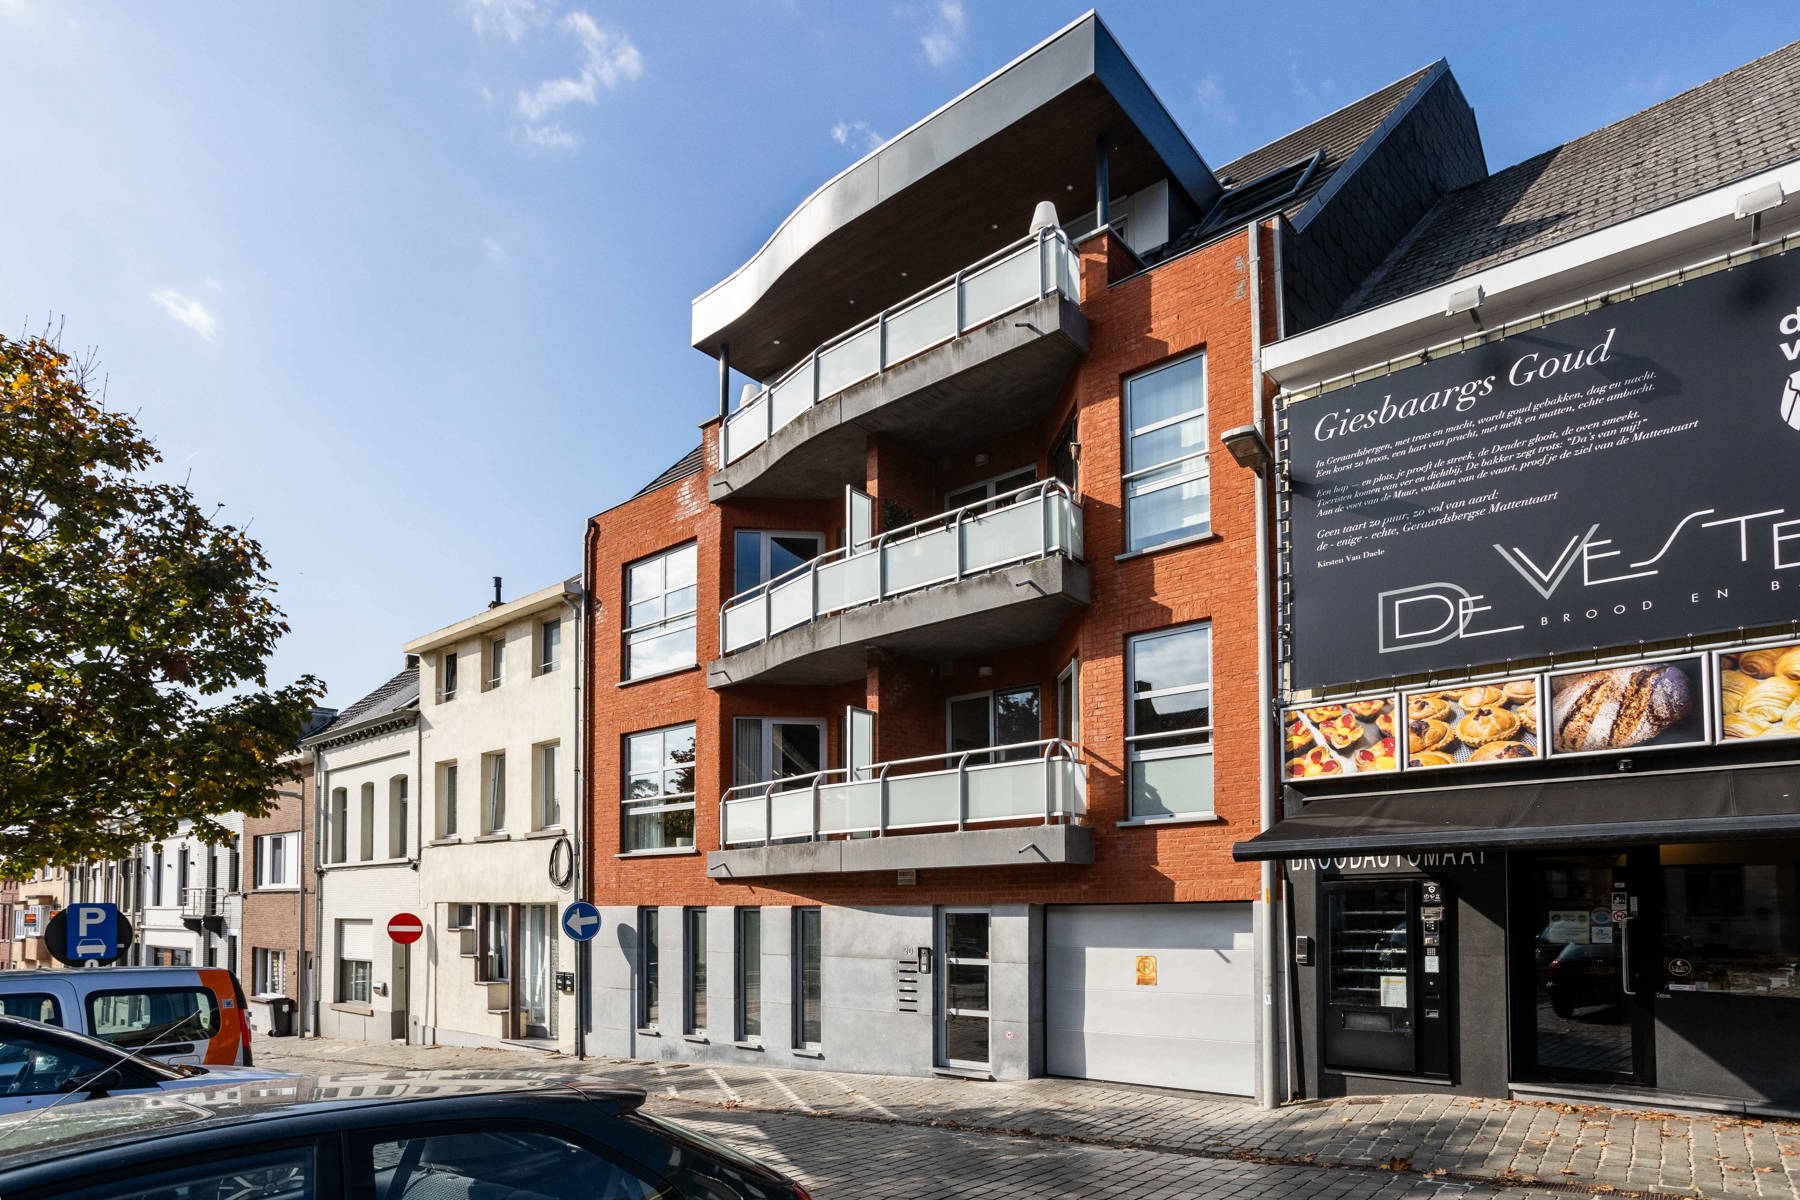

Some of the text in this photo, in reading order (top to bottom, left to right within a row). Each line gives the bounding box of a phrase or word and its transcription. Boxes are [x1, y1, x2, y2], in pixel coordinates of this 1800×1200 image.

[1780, 306, 1800, 335] d
[1314, 328, 1617, 442] Giesbaargs Goud
[1316, 460, 1324, 469] In
[1327, 443, 1392, 465] Geraardsbergen,
[1395, 439, 1410, 447] met
[1412, 433, 1431, 443] trots
[1445, 420, 1475, 434] macht,
[1478, 410, 1505, 425] wordt
[1507, 403, 1532, 419] goud
[1533, 392, 1584, 412] gebakken,
[1586, 385, 1608, 396] dag
[1609, 381, 1622, 390] en
[1624, 371, 1657, 386] nacht.
[1316, 470, 1332, 479] Een
[1333, 464, 1353, 474] korst
[1365, 455, 1390, 466] broos,
[1392, 450, 1406, 458] een
[1409, 443, 1427, 454] hart
[1429, 440, 1445, 448] van
[1446, 430, 1479, 447] pracht,
[1481, 426, 1498, 435] met
[1500, 417, 1522, 430] melk
[1524, 415, 1536, 424] en
[1539, 406, 1575, 420] matten,
[1578, 395, 1605, 409] echte
[1607, 384, 1656, 402] ambacht.
[1316, 488, 1332, 497] Een
[1334, 486, 1349, 495] hap
[1362, 479, 1372, 487] en
[1372, 473, 1395, 486] plots,
[1396, 470, 1406, 480] je
[1406, 461, 1433, 478] proeft
[1434, 459, 1445, 468] de
[1446, 451, 1476, 465] streek,
[1478, 448, 1490, 457] de
[1491, 439, 1527, 454] Dender
[1528, 431, 1559, 447] glooit,
[1562, 426, 1574, 437] de
[1576, 421, 1600, 433] oven
[1602, 410, 1640, 427] smeekt.
[1316, 508, 1333, 518] Aan
[1335, 504, 1344, 513] de
[1346, 501, 1361, 511] voet
[1381, 494, 1392, 502] de
[1393, 490, 1419, 502] Muur,
[1421, 480, 1456, 493] voldaan
[1459, 475, 1475, 483] van
[1477, 470, 1489, 479] de
[1491, 464, 1518, 476] vaart,
[1560, 450, 1572, 459] de
[1574, 444, 1593, 456] ziel
[1595, 441, 1614, 451] van
[1616, 436, 1629, 447] de
[1631, 420, 1699, 442] Mattentaart
[1383, 482, 1398, 491] van
[1415, 477, 1426, 485] en
[1465, 462, 1479, 472] De
[1481, 454, 1514, 467] bakker
[1516, 448, 1536, 459] zegt
[1538, 442, 1564, 454] trots:
[1598, 430, 1617, 439] van
[1317, 489, 1500, 539] Geen taart zo puur, zo vol van aard:
[1317, 542, 1328, 551] de
[1337, 535, 1363, 547] enige
[1371, 526, 1399, 540] echte,
[1403, 508, 1486, 533] Geraardsbergse
[1488, 492, 1558, 514] Mattentaart
[1317, 549, 1385, 569] Kirsten Van Daele
[1378, 508, 1800, 654] DE VESTE
[1540, 600, 1653, 627] BROOD
[1691, 588, 1729, 603] EN
[79, 908, 106, 937] P
